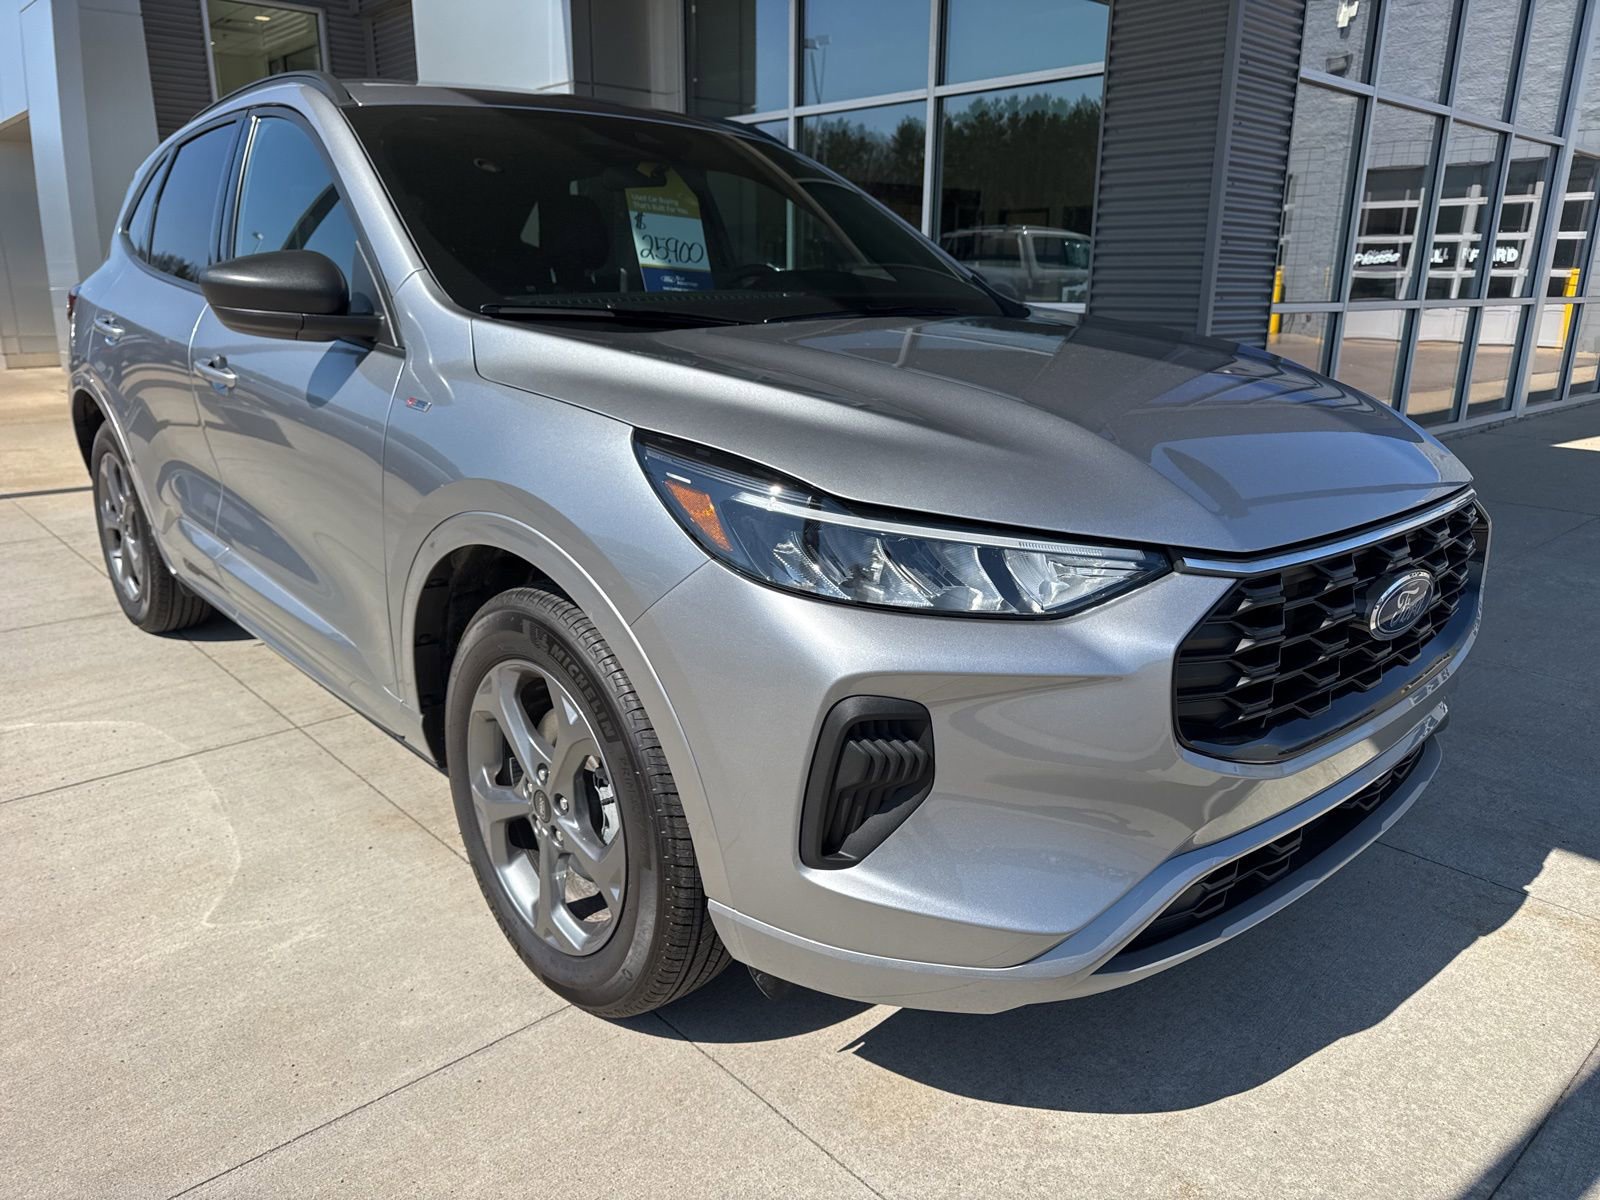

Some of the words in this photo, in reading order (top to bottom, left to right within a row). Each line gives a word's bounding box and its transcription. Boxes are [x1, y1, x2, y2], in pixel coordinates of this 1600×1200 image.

[634, 212, 646, 230] $
[1388, 586, 1428, 627] Ford
[549, 643, 618, 738] MICHELIN
